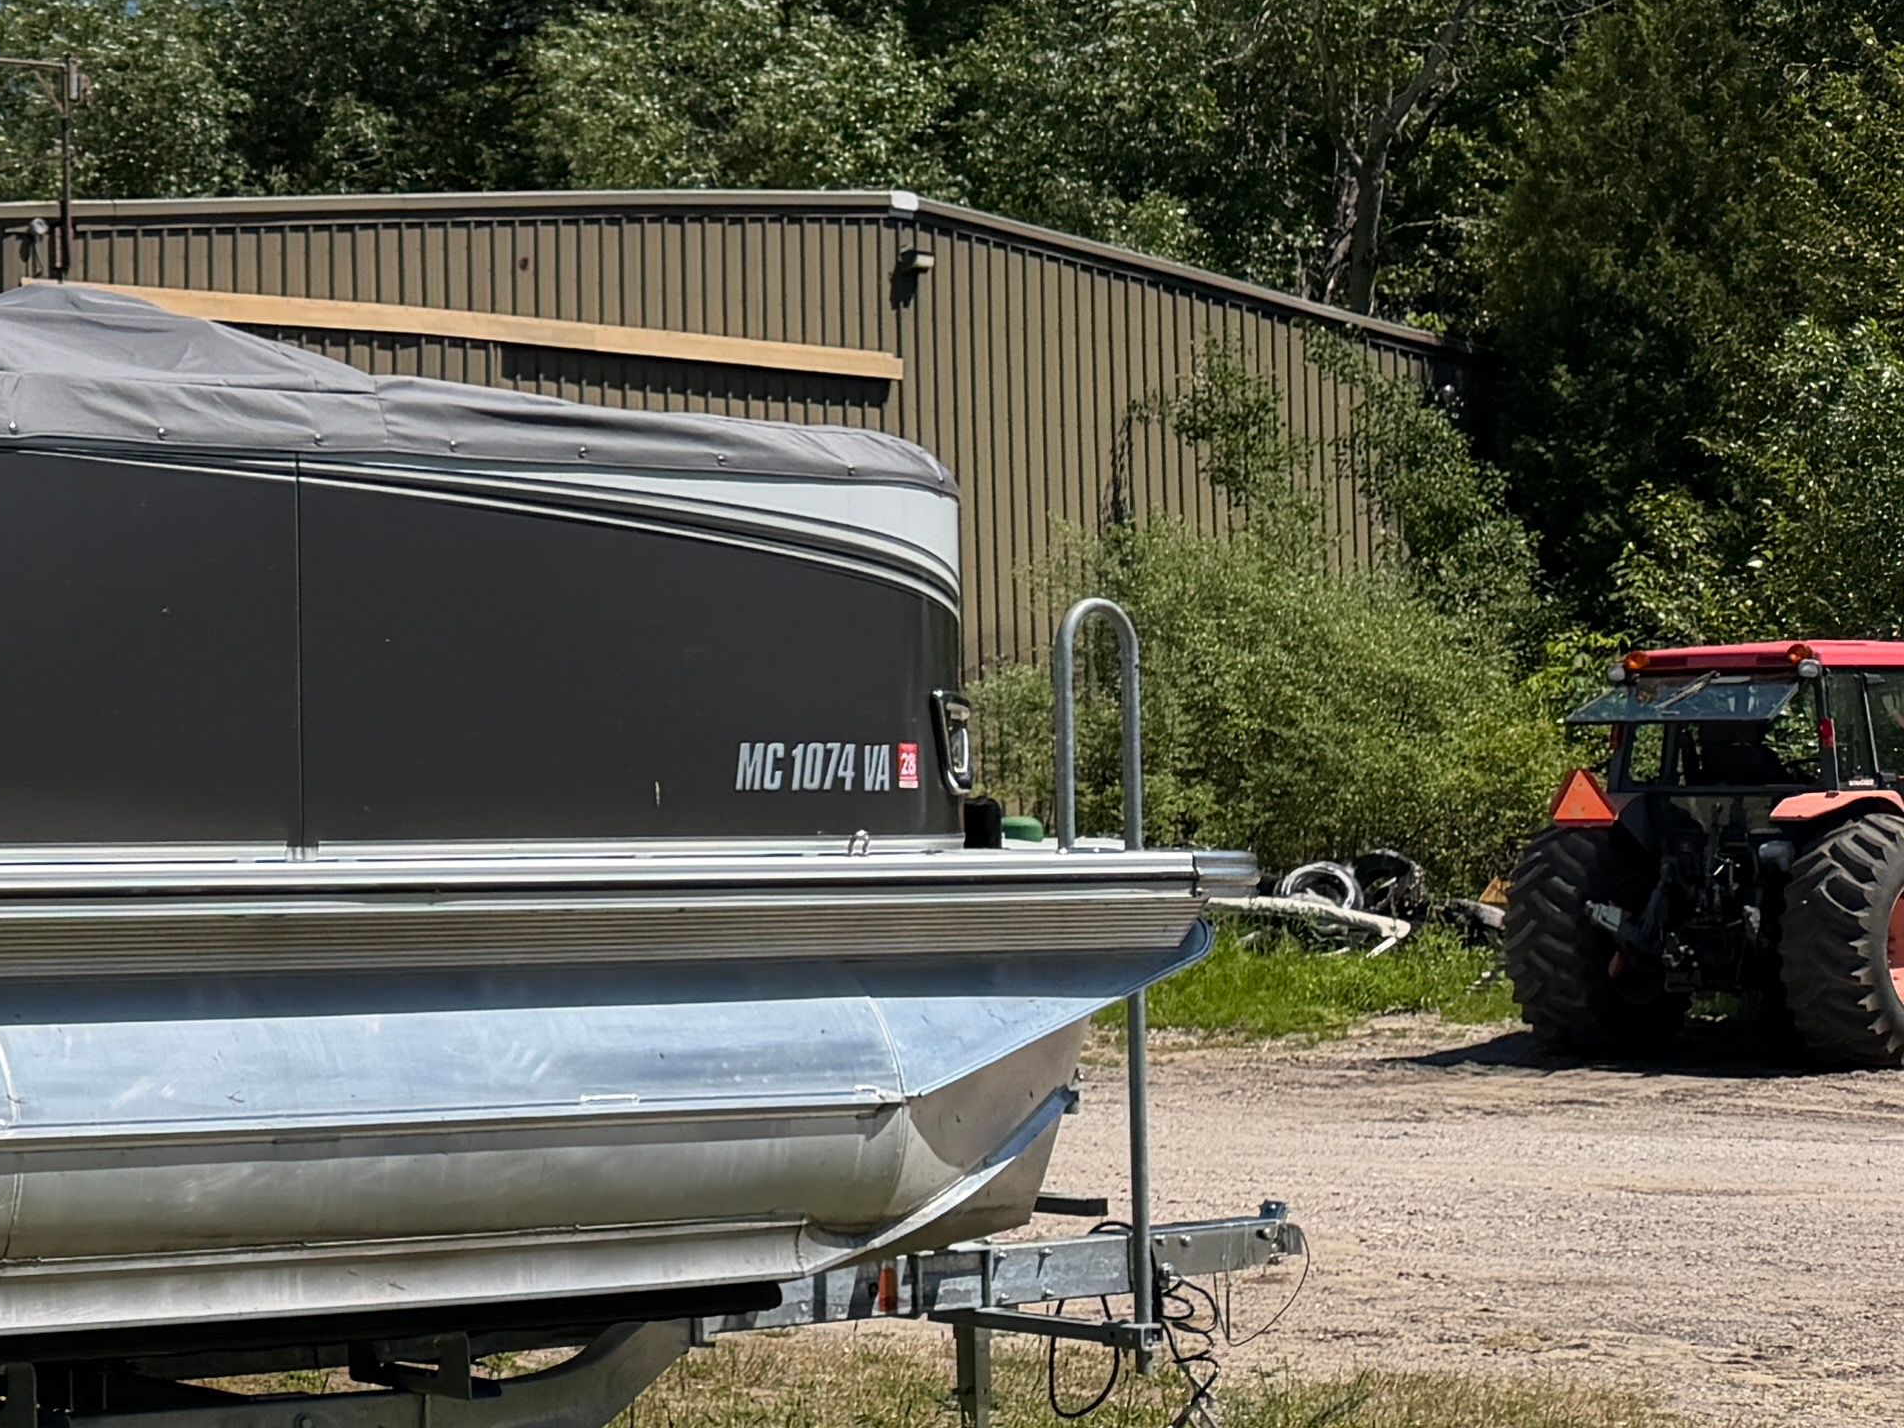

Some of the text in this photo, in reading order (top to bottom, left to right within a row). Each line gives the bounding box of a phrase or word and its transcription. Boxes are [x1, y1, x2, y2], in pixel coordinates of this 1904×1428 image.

[735, 742, 891, 792] MC 1074 VA
